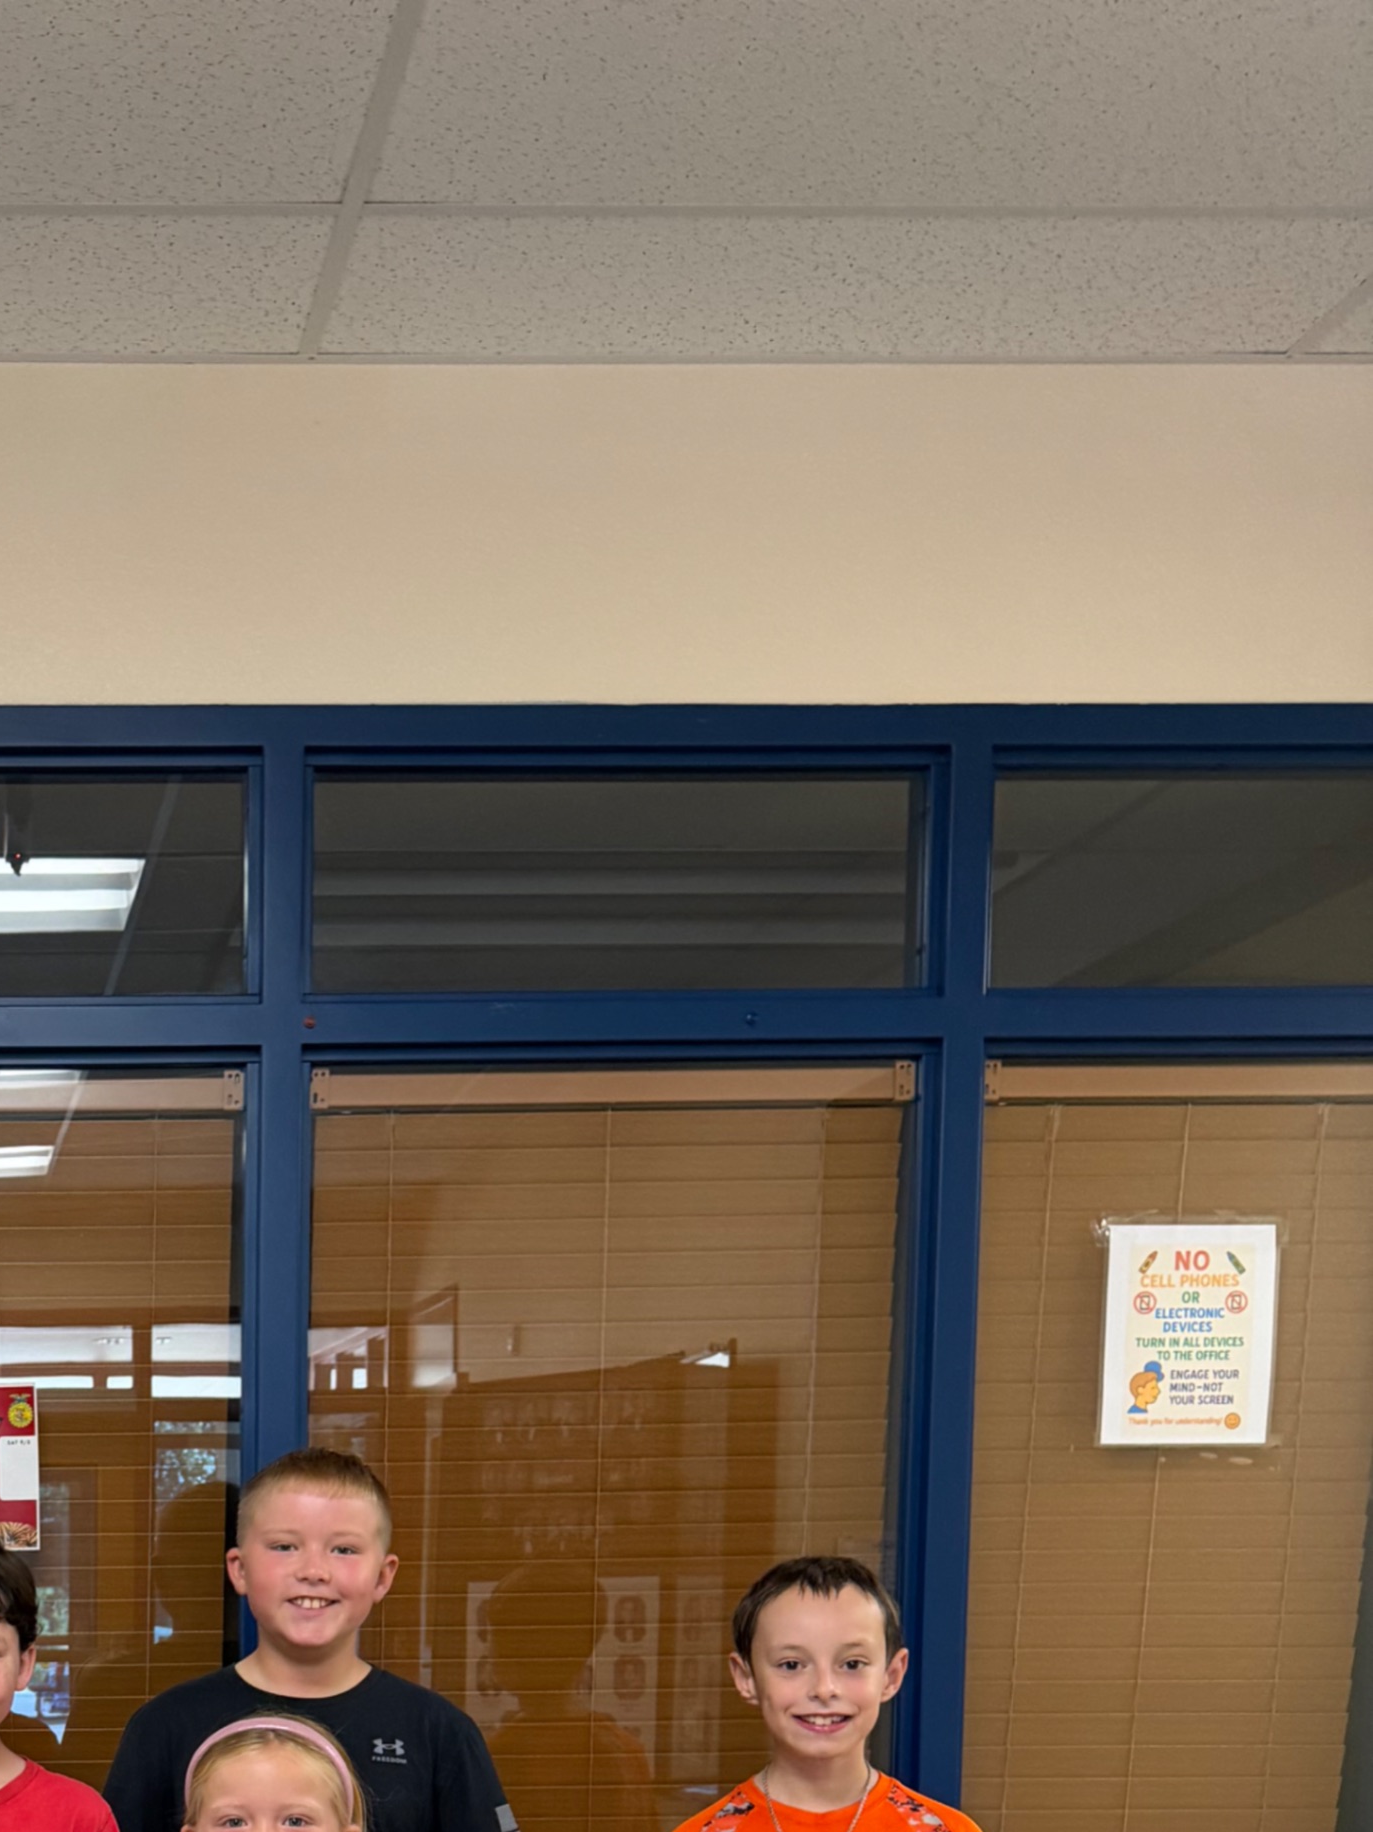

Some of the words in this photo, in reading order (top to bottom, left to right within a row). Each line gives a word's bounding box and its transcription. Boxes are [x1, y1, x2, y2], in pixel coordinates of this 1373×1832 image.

[1174, 1250, 1210, 1270] NO
[1140, 1275, 1175, 1288] CELL
[1180, 1274, 1239, 1288] PHONES
[1181, 1291, 1200, 1304] OR
[1155, 1308, 1224, 1319] ELECTRONIC
[1163, 1321, 1212, 1333] DEVICES
[1135, 1337, 1166, 1347] TURN
[1169, 1337, 1180, 1347] IN
[1183, 1337, 1200, 1347] ALL
[1203, 1337, 1244, 1347] DEVICES
[1157, 1351, 1171, 1361] TO
[1174, 1350, 1193, 1361] THE
[1196, 1350, 1230, 1361] OFFICE
[1170, 1370, 1209, 1380] ENGAGE
[1212, 1369, 1239, 1379] YOUR
[1169, 1395, 1195, 1405] YOUR
[1198, 1394, 1234, 1405] SCREEN
[1129, 1417, 1148, 1425] Thank
[1164, 1417, 1173, 1425] for
